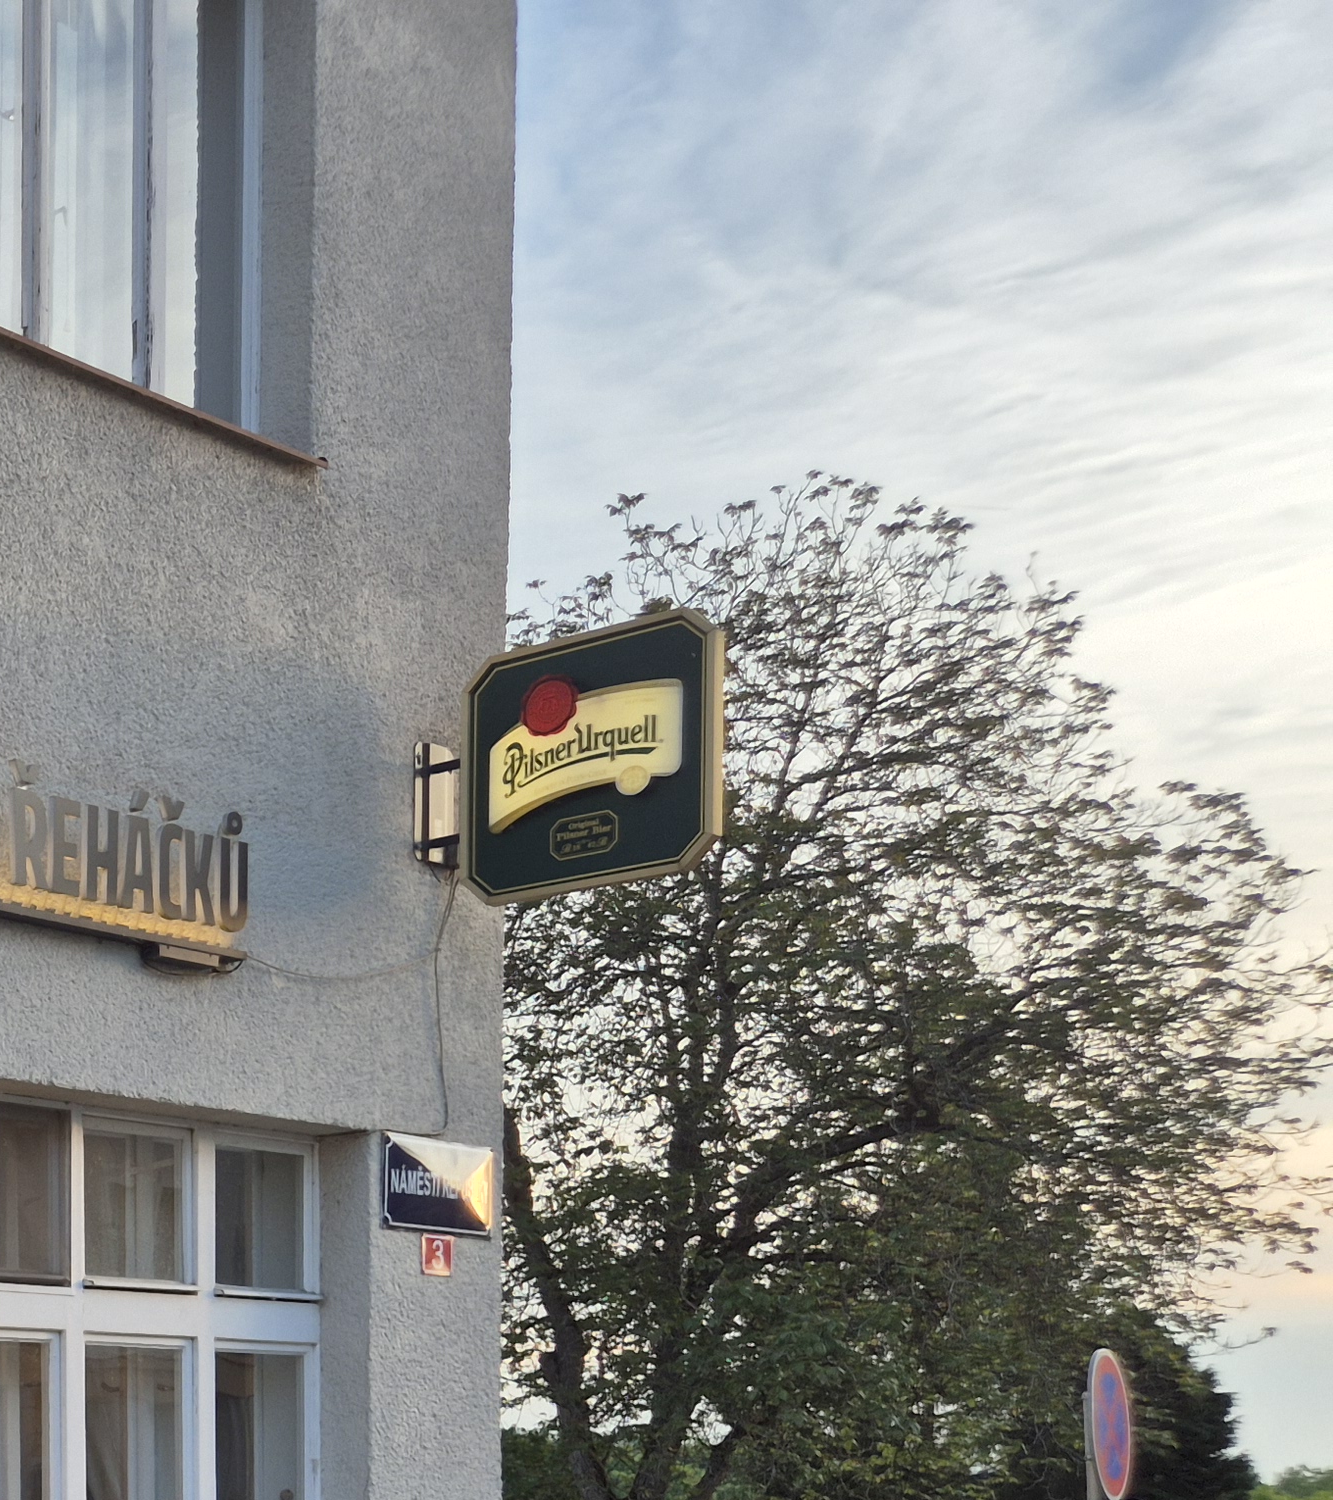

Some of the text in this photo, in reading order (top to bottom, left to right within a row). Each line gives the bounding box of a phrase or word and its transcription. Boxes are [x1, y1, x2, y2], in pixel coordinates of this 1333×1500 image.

[501, 738, 577, 799] Pilsner
[574, 714, 658, 762] Urquell
[8, 758, 249, 933] ŘEHÁČKŮ
[432, 1240, 445, 1270] 3
